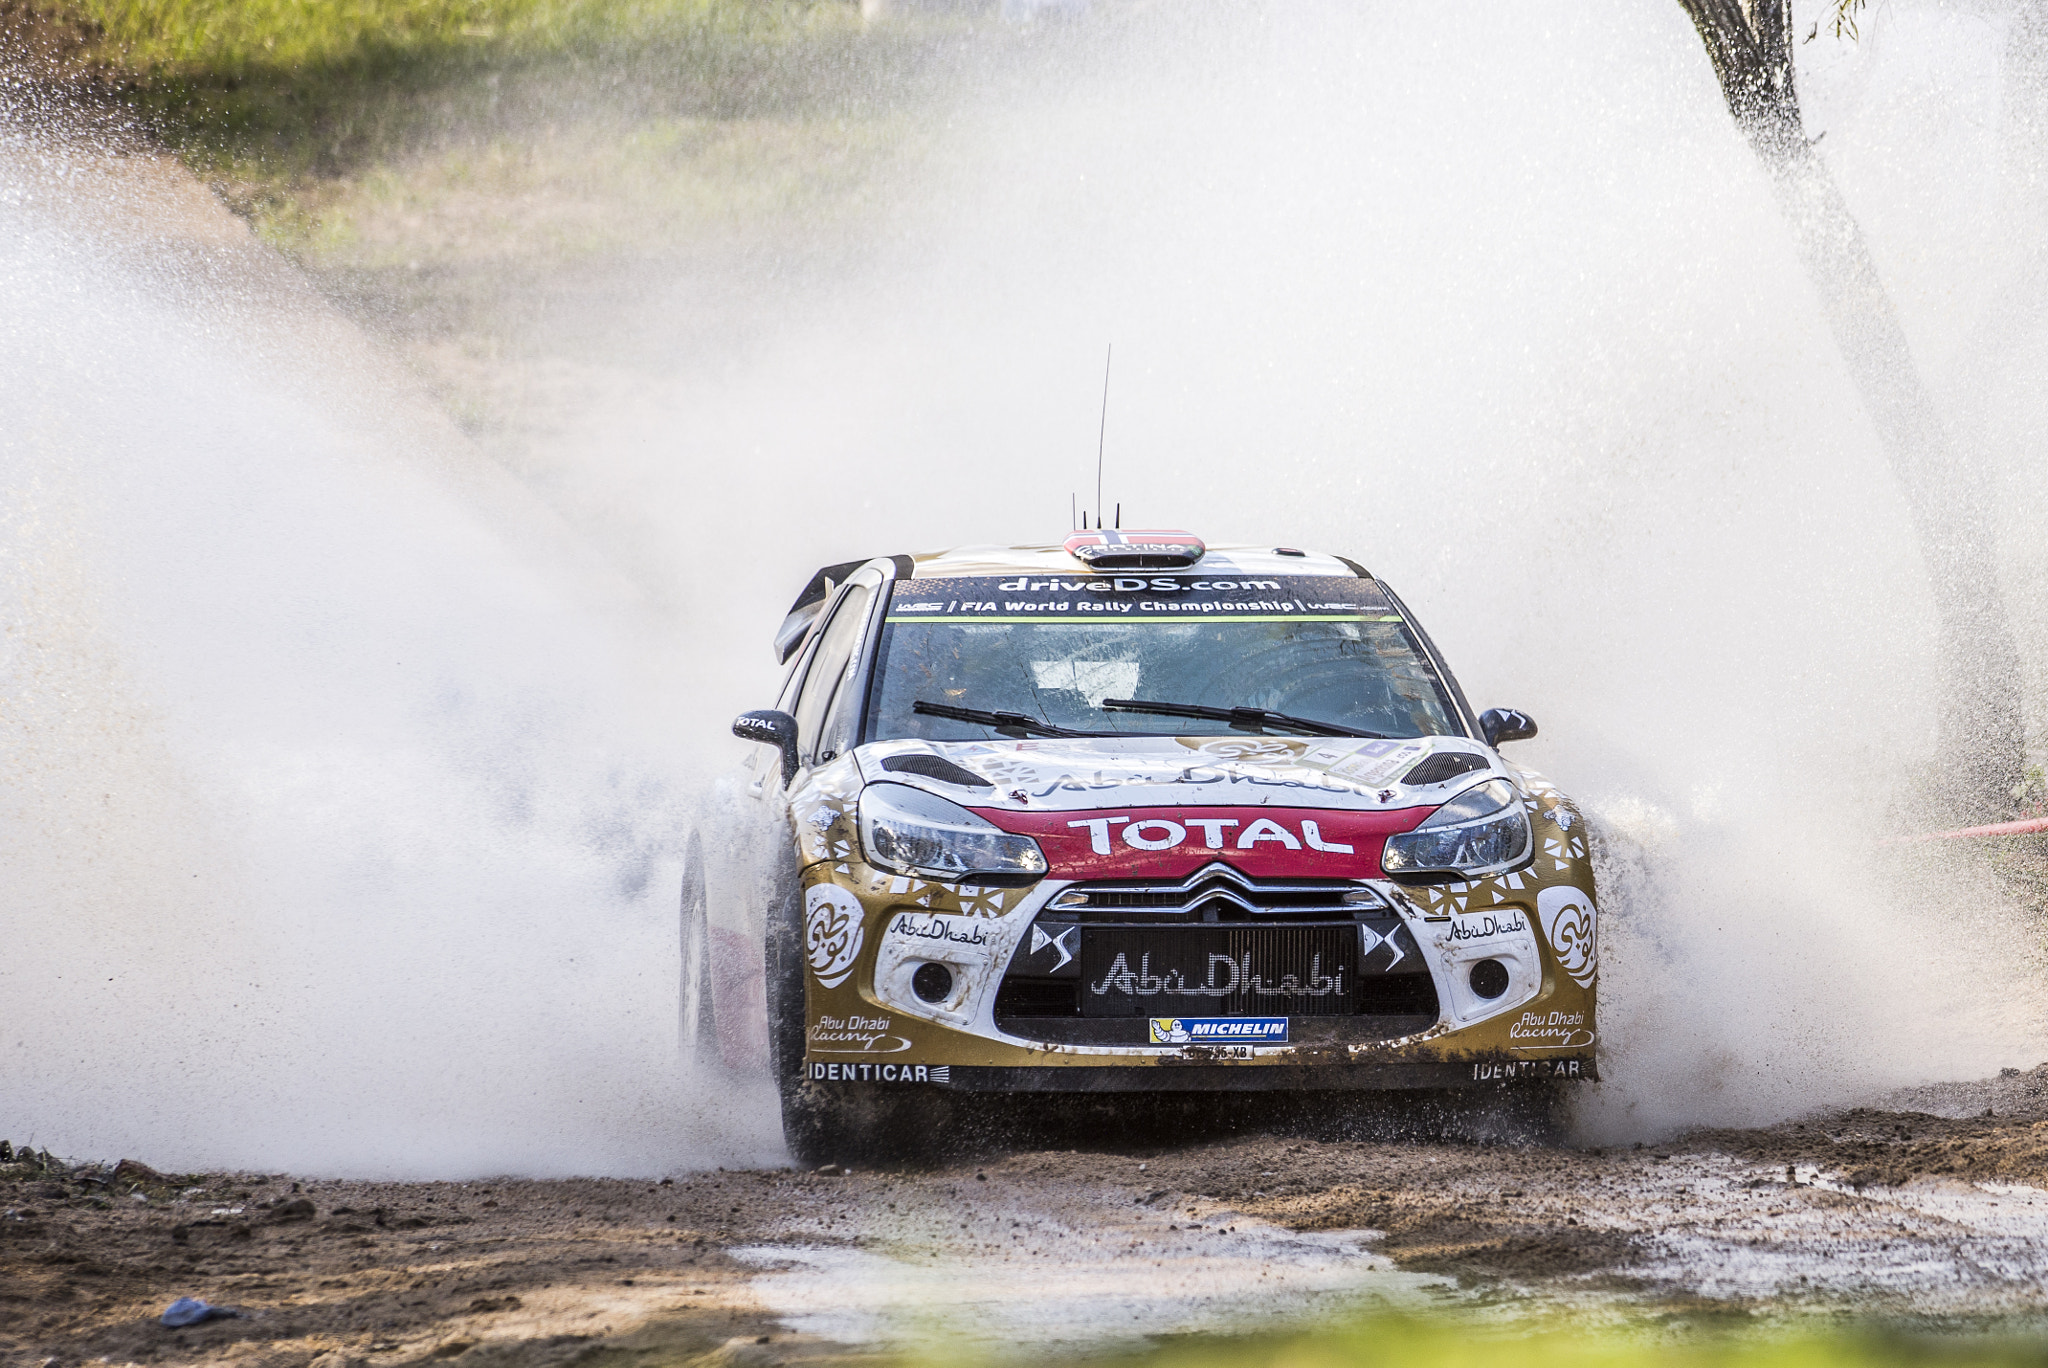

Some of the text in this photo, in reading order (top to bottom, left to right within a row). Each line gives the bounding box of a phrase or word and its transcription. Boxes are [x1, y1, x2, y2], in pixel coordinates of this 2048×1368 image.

[998, 577, 1281, 592] driveDS.com
[960, 600, 1294, 613] FIA World Rally Championship
[735, 716, 776, 731] TOTAL
[1067, 816, 1355, 856] TOTAL
[820, 1015, 891, 1030] Abu Dhabi
[1520, 1010, 1585, 1026] Abu Dhabi
[1191, 1023, 1285, 1035] MICHELIN
[1509, 1022, 1581, 1045] Racing
[810, 1024, 886, 1050] Racing
[808, 1062, 928, 1082] IDENTICAR
